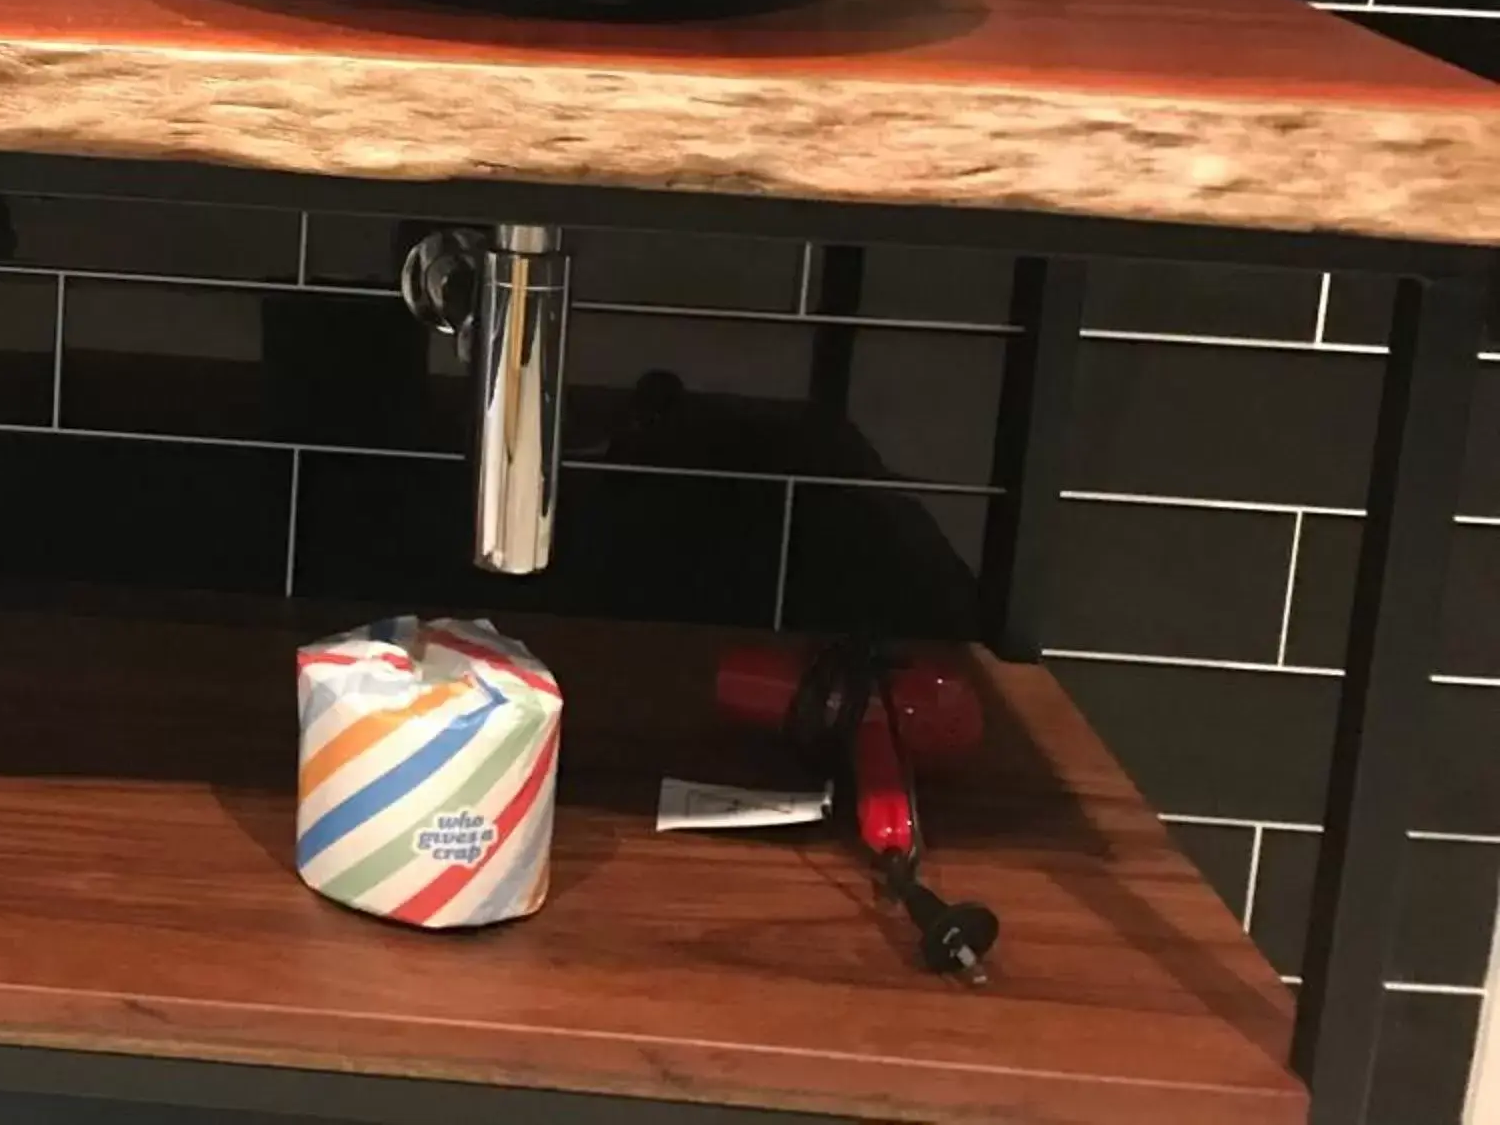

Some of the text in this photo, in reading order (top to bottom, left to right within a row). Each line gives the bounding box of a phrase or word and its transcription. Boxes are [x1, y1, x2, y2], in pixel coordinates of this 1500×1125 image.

[438, 810, 484, 830] who
[418, 829, 493, 850] gives a
[432, 846, 481, 864] crap
